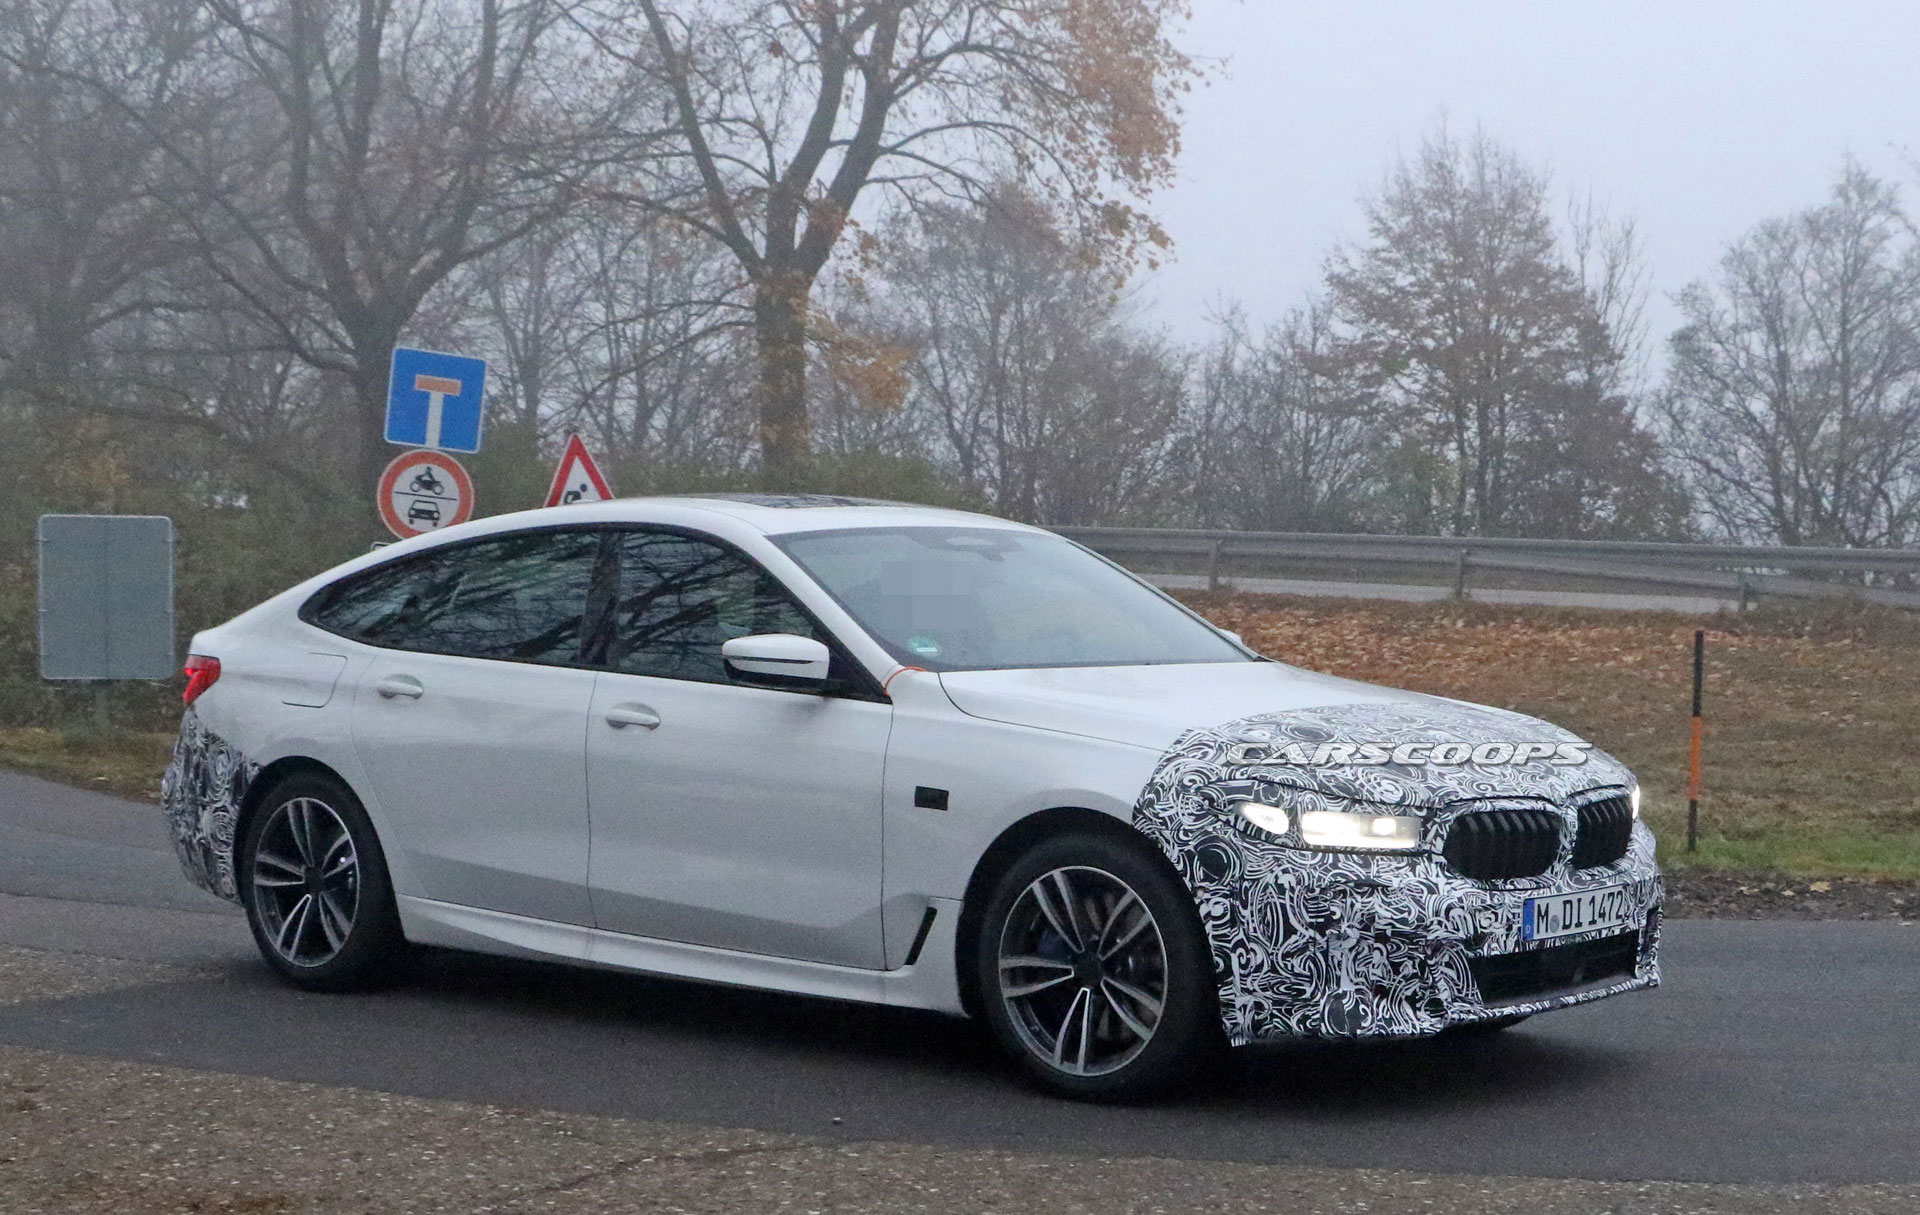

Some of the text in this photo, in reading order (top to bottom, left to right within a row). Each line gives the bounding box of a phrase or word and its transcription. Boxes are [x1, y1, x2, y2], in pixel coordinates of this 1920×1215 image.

[1536, 889, 1624, 934] M DI 1472
